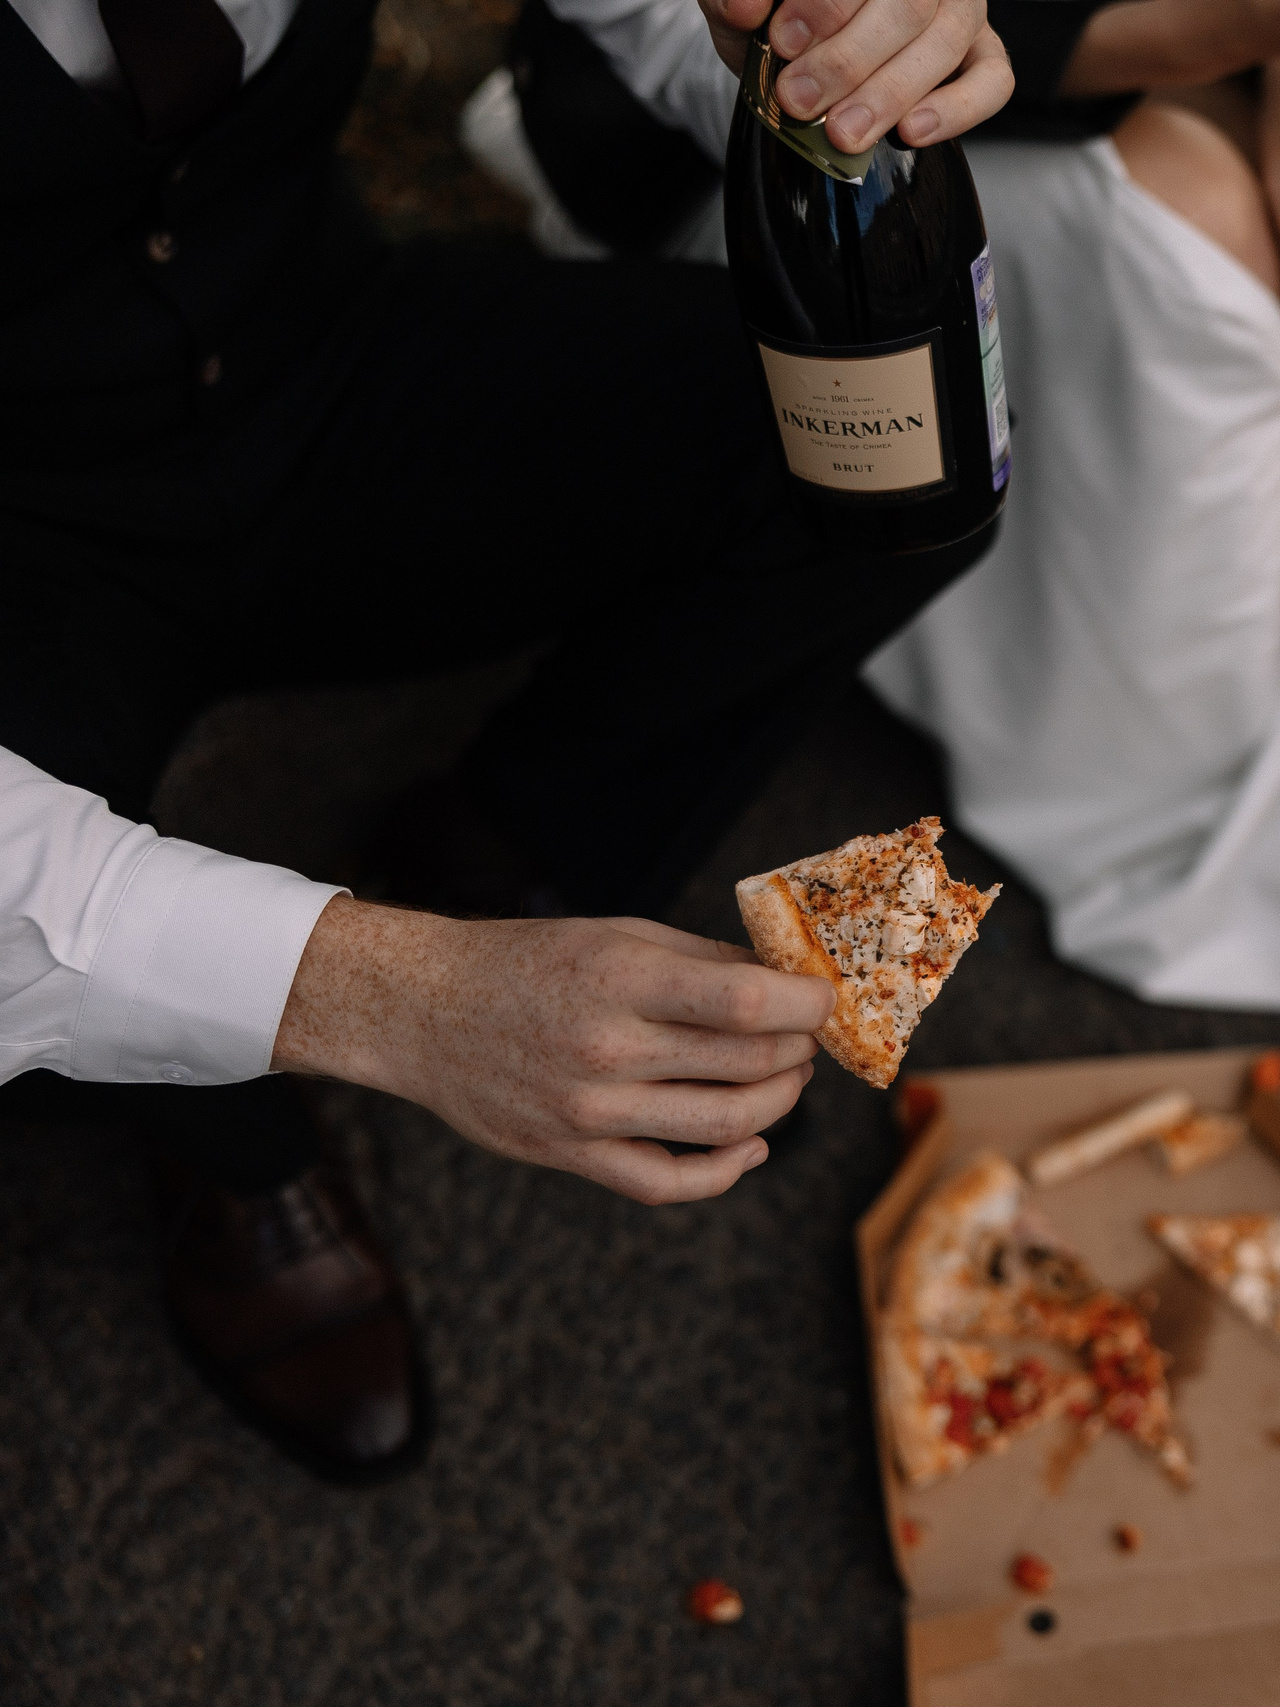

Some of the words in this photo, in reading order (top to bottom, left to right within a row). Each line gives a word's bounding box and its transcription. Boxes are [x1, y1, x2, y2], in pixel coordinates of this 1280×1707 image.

[831, 395, 850, 403] 1961
[795, 403, 859, 417] SPARKLING
[862, 407, 893, 416] WINE
[781, 407, 924, 439] INKERMAN
[863, 443, 892, 451] CRIMEA
[833, 462, 875, 473] BRUT
